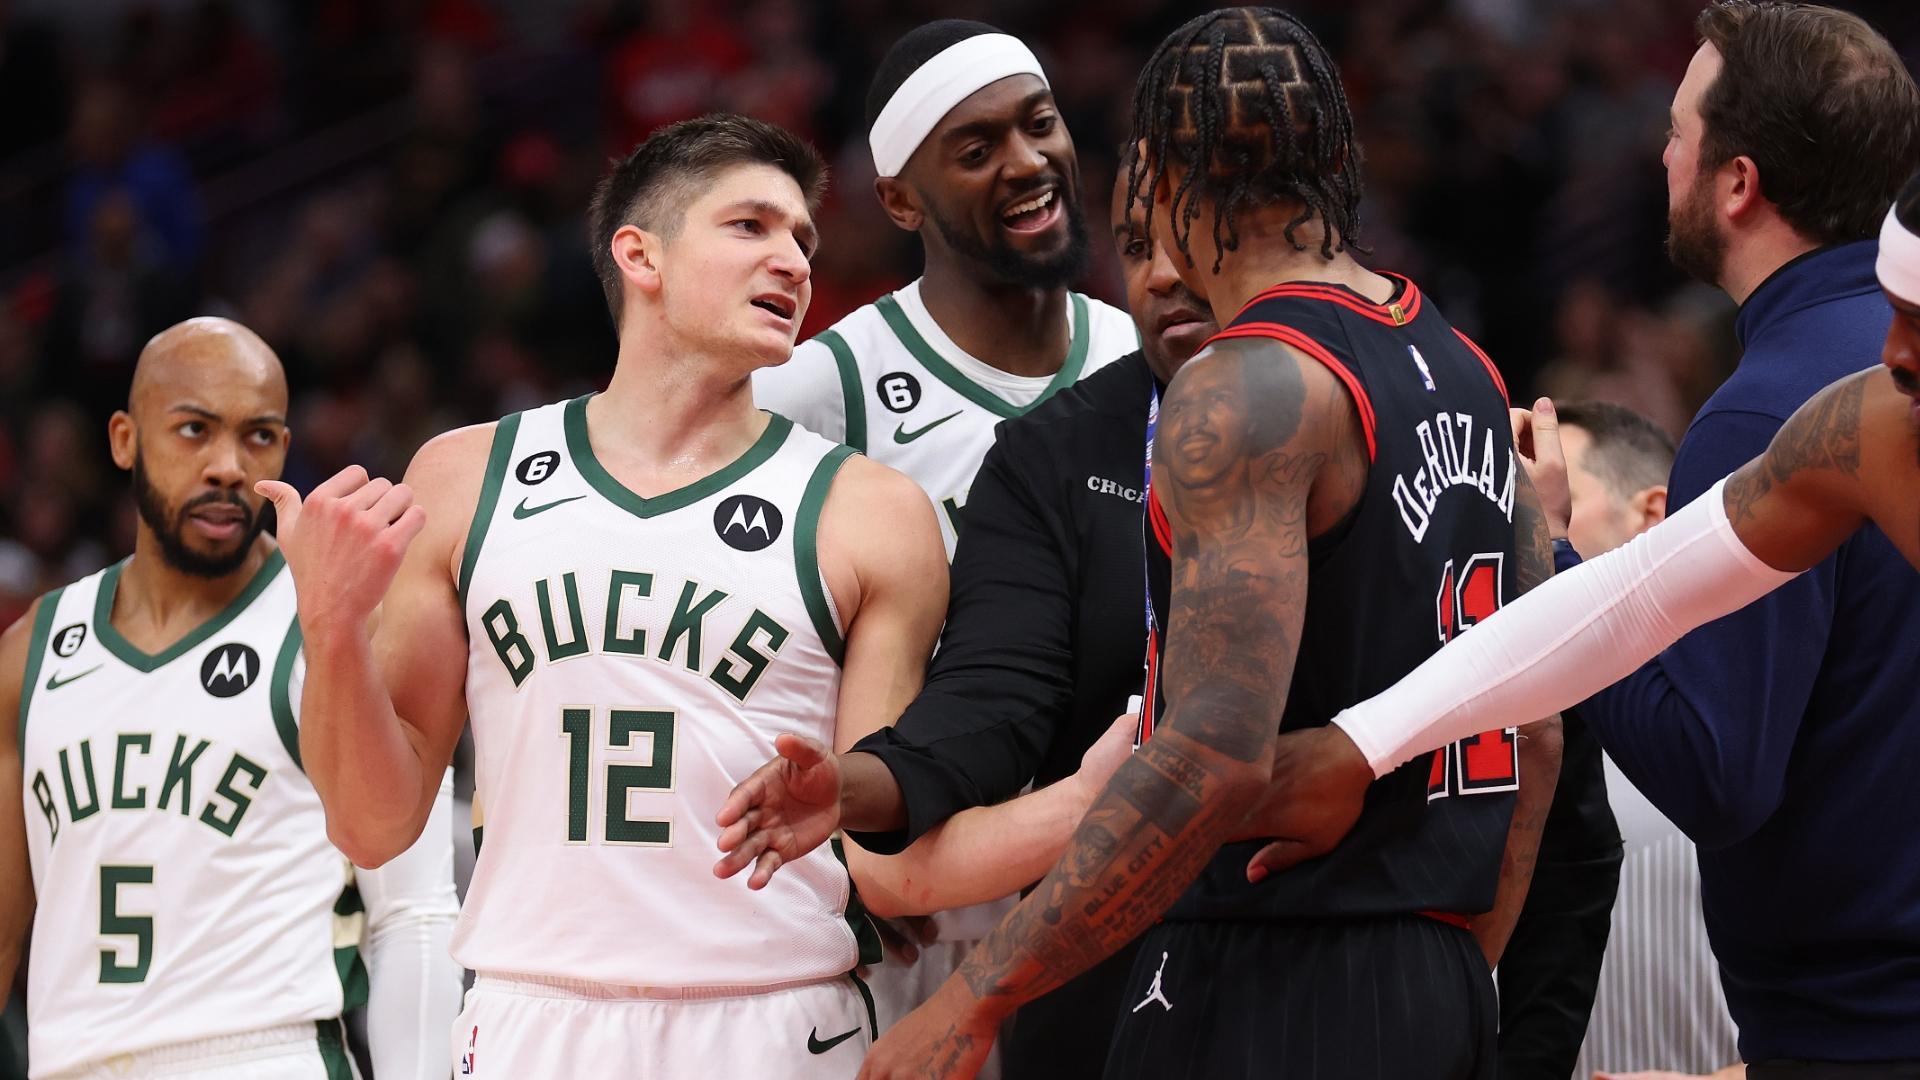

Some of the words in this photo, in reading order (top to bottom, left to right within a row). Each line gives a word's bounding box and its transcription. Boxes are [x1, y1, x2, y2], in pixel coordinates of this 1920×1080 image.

[885, 378, 913, 409] 6
[526, 456, 552, 481] 6
[61, 624, 83, 656] 6
[481, 568, 791, 703] BUCKS
[32, 732, 269, 844] BUCKS
[559, 705, 678, 847] 12
[98, 865, 154, 984] 5
[1083, 873, 1128, 917] BLUE
[1128, 835, 1163, 875] CITY
